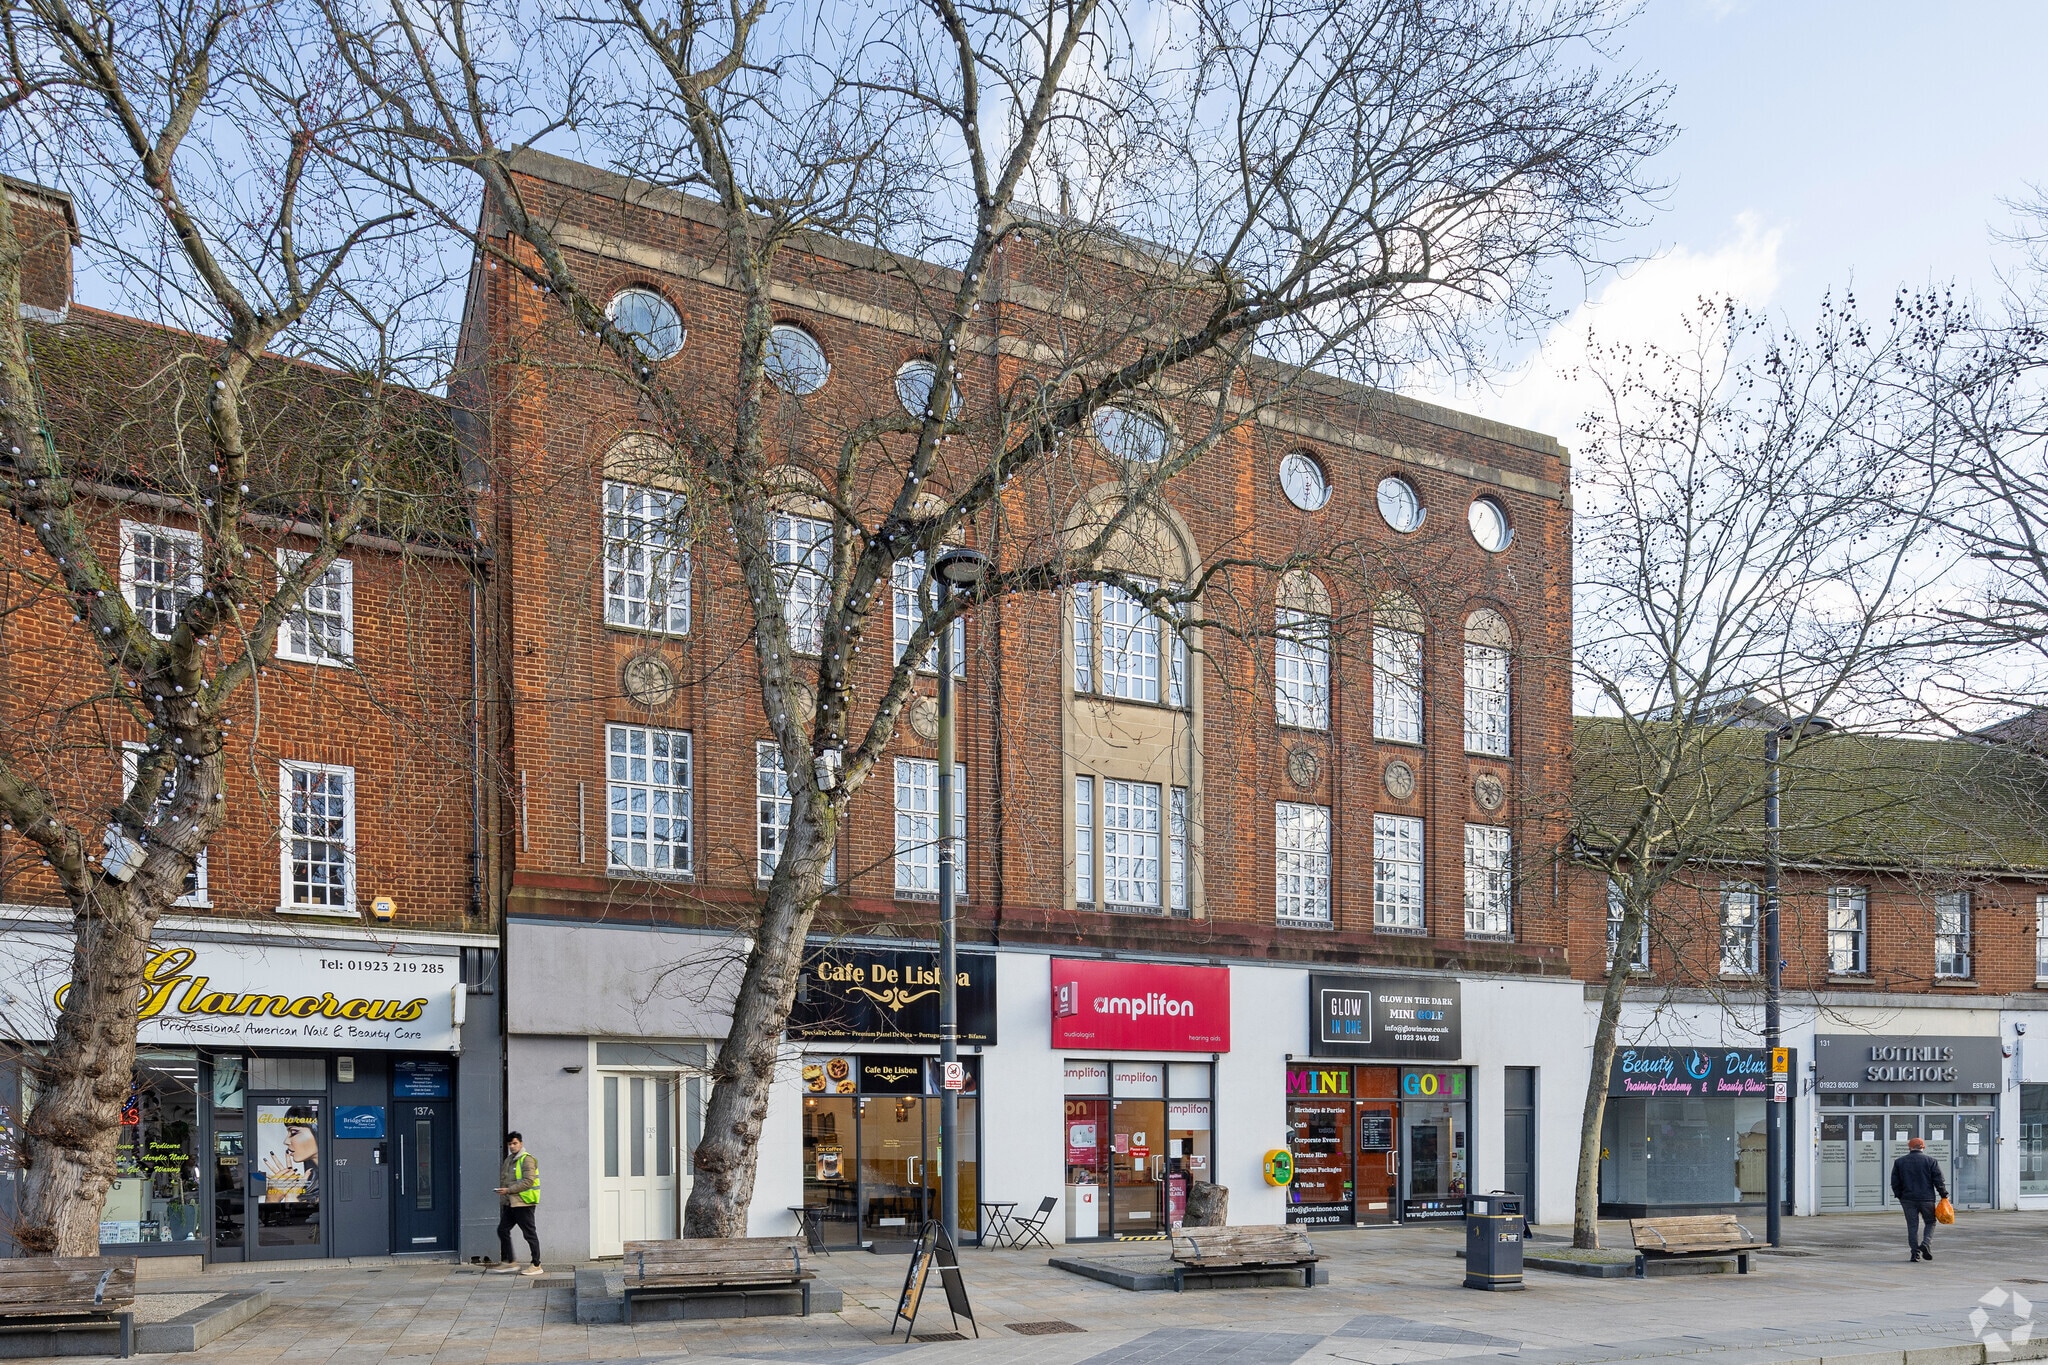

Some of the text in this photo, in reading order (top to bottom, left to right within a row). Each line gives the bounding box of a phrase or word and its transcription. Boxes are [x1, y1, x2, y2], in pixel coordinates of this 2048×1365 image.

[320, 959, 444, 974] Tel: 01923 219 285
[817, 962, 971, 987] Cafe De Lisa
[54, 947, 428, 1022] Glamorous
[1094, 993, 1194, 1020] amplifon
[1379, 995, 1453, 1006] GLOW IN THE DARK
[1331, 998, 1362, 1016] GLOW
[1389, 1009, 1444, 1021] MINI GOLF
[160, 1019, 421, 1040] Professional American Nail & Beauty Care
[1331, 1019, 1362, 1035] IN ONE
[1384, 1025, 1449, 1034] info@glowinone.co.uk
[1064, 1031, 1095, 1039] audiologist
[1189, 1035, 1209, 1043] hearing
[1871, 1045, 1954, 1062] BOTTRILLS
[864, 1066, 918, 1075] Cafe De Lisboa
[1622, 1050, 1674, 1079] Beauty
[1725, 1052, 1766, 1075] Delux
[1115, 1072, 1158, 1084] amplifon
[1866, 1065, 1958, 1082] SOLICITORS
[1286, 1071, 1466, 1095] MINI GOLF
[1624, 1077, 1766, 1096] Training Academy & Beauty Clinic
[275, 1097, 291, 1105] 137
[1294, 1107, 1320, 1115] Birthdays
[257, 1113, 318, 1125] Glamorous
[343, 1116, 376, 1125] Bridgewater
[1294, 1121, 1308, 1129] Café
[150, 1141, 181, 1149] Pedicure
[140, 1153, 189, 1162] Acrylic Nails
[127, 1166, 140, 1174] Gel
[154, 1166, 181, 1174] Waxing
[1406, 1209, 1464, 1219] www.glowinone.co.uk
